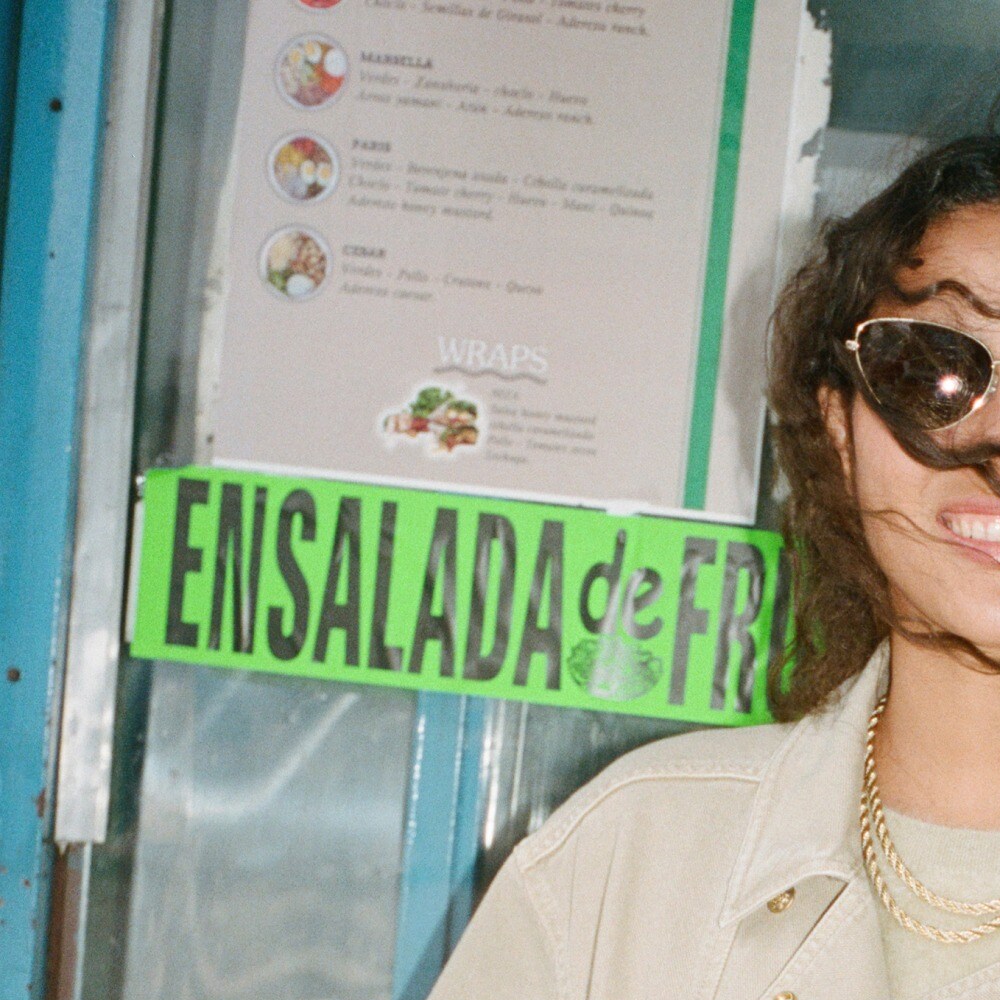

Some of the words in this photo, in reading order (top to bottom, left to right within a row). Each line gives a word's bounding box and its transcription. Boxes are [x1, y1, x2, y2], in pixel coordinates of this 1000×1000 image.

[360, 52, 433, 69] MARSELLA
[351, 138, 392, 153] PARIS
[437, 335, 549, 374] WRAPS
[164, 477, 564, 692] ENSALADA
[579, 529, 664, 640] de
